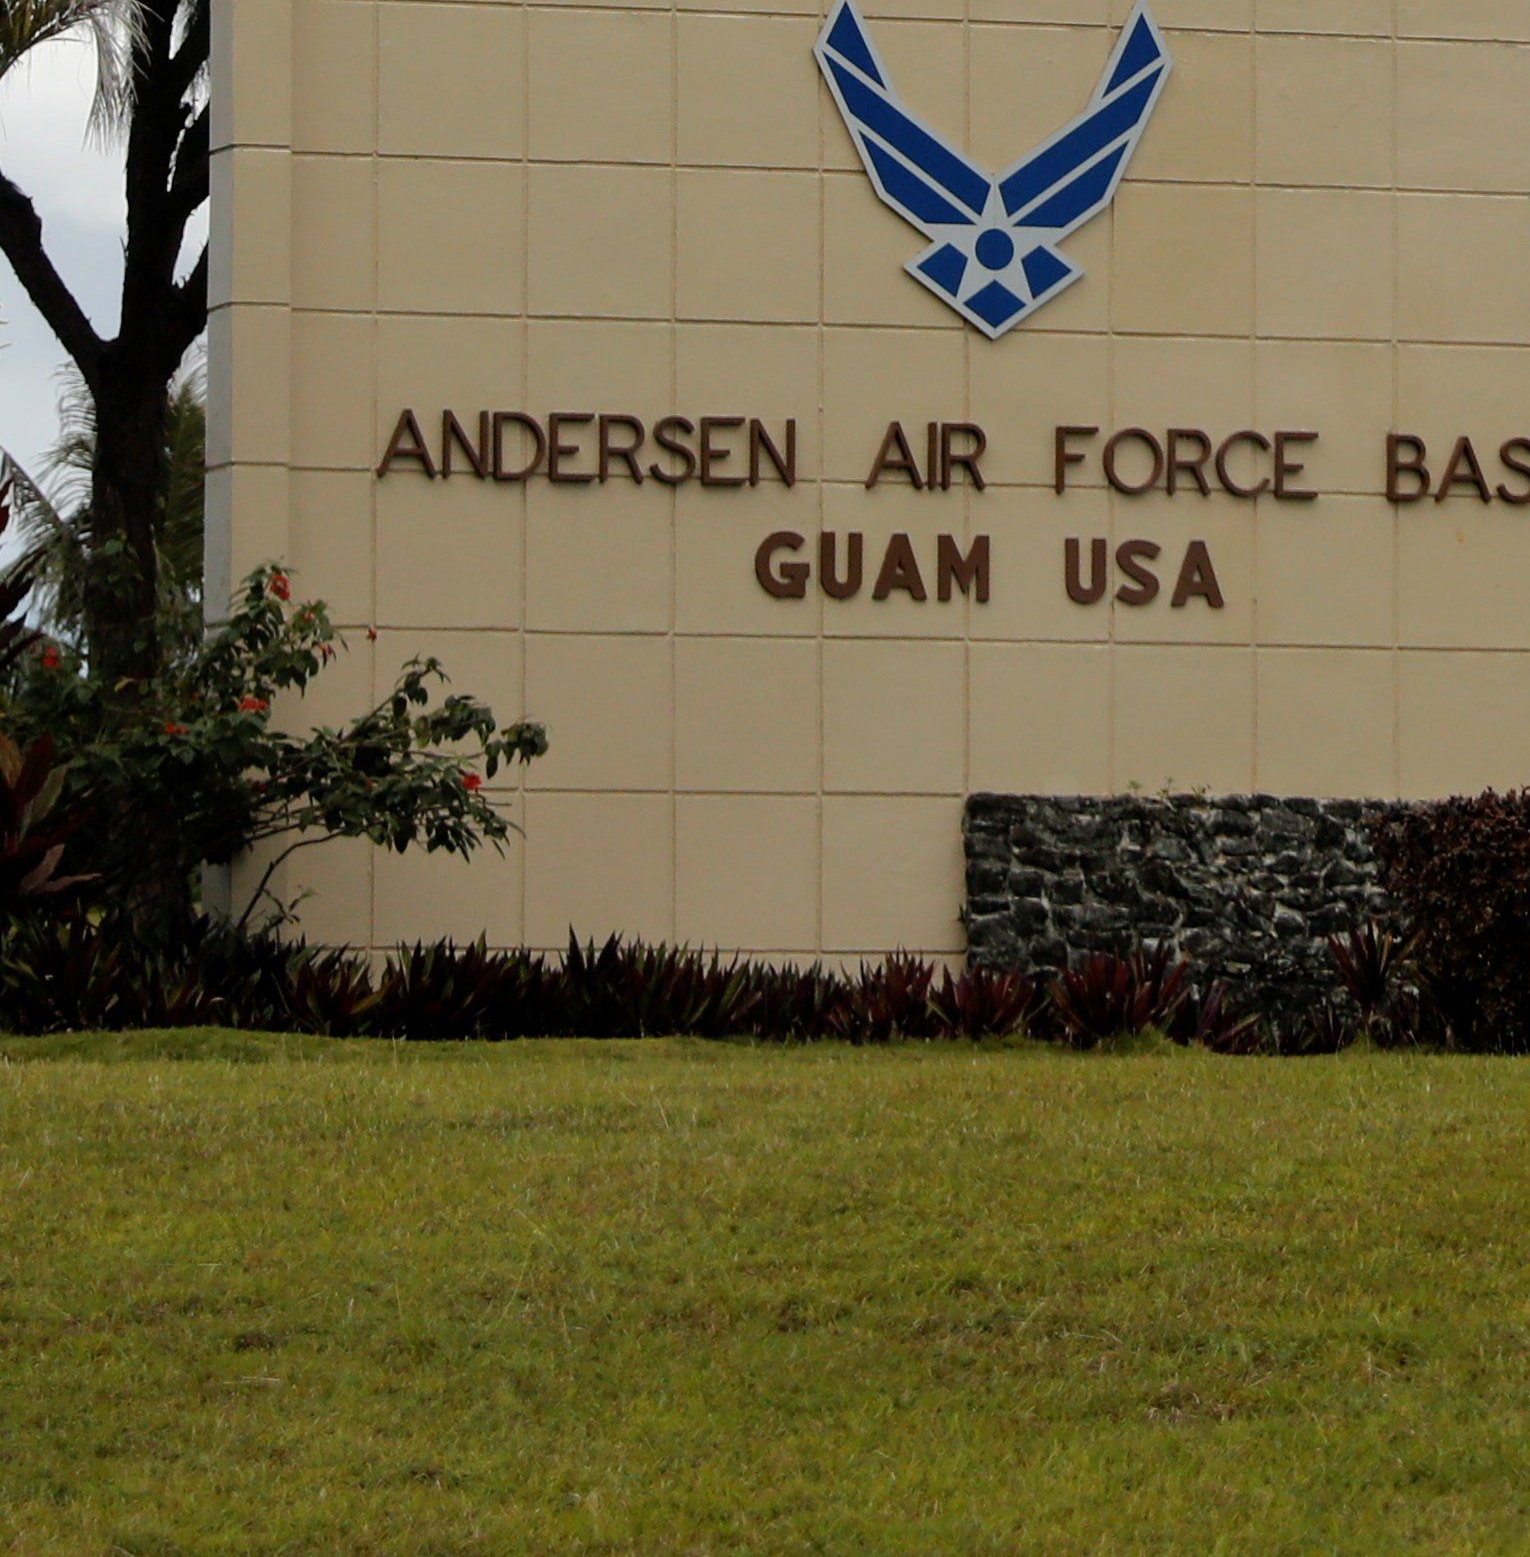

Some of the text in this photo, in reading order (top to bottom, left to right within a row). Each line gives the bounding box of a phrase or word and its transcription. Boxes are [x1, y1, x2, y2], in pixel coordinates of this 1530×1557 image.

[377, 408, 796, 488] ANDERSEN
[865, 421, 987, 491] AIR
[1055, 426, 1319, 501] FORCE
[754, 531, 1225, 609] GUAM USA
